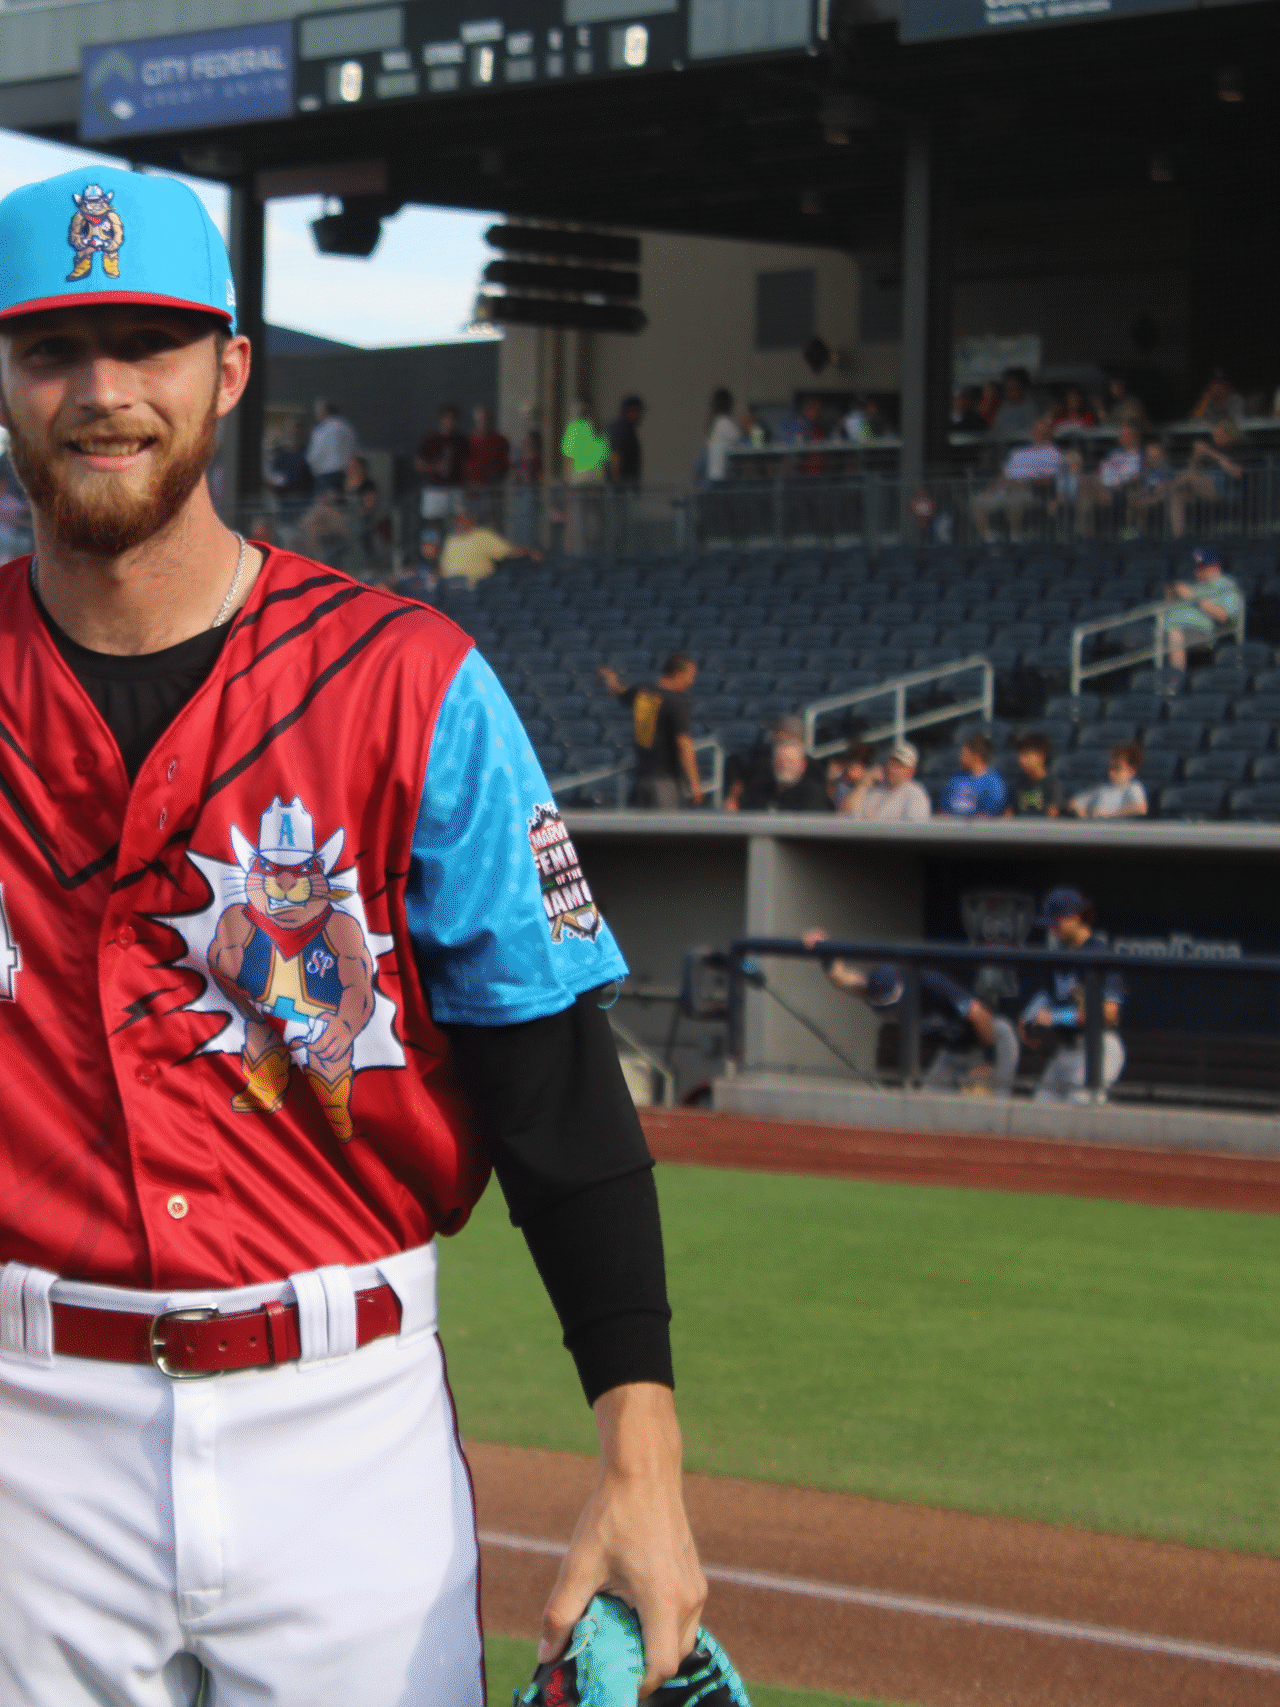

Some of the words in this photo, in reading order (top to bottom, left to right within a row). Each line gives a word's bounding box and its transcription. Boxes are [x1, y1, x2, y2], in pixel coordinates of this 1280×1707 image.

[190, 45, 287, 81] FEDERAL
[278, 813, 296, 847] A
[306, 949, 334, 978] SP
